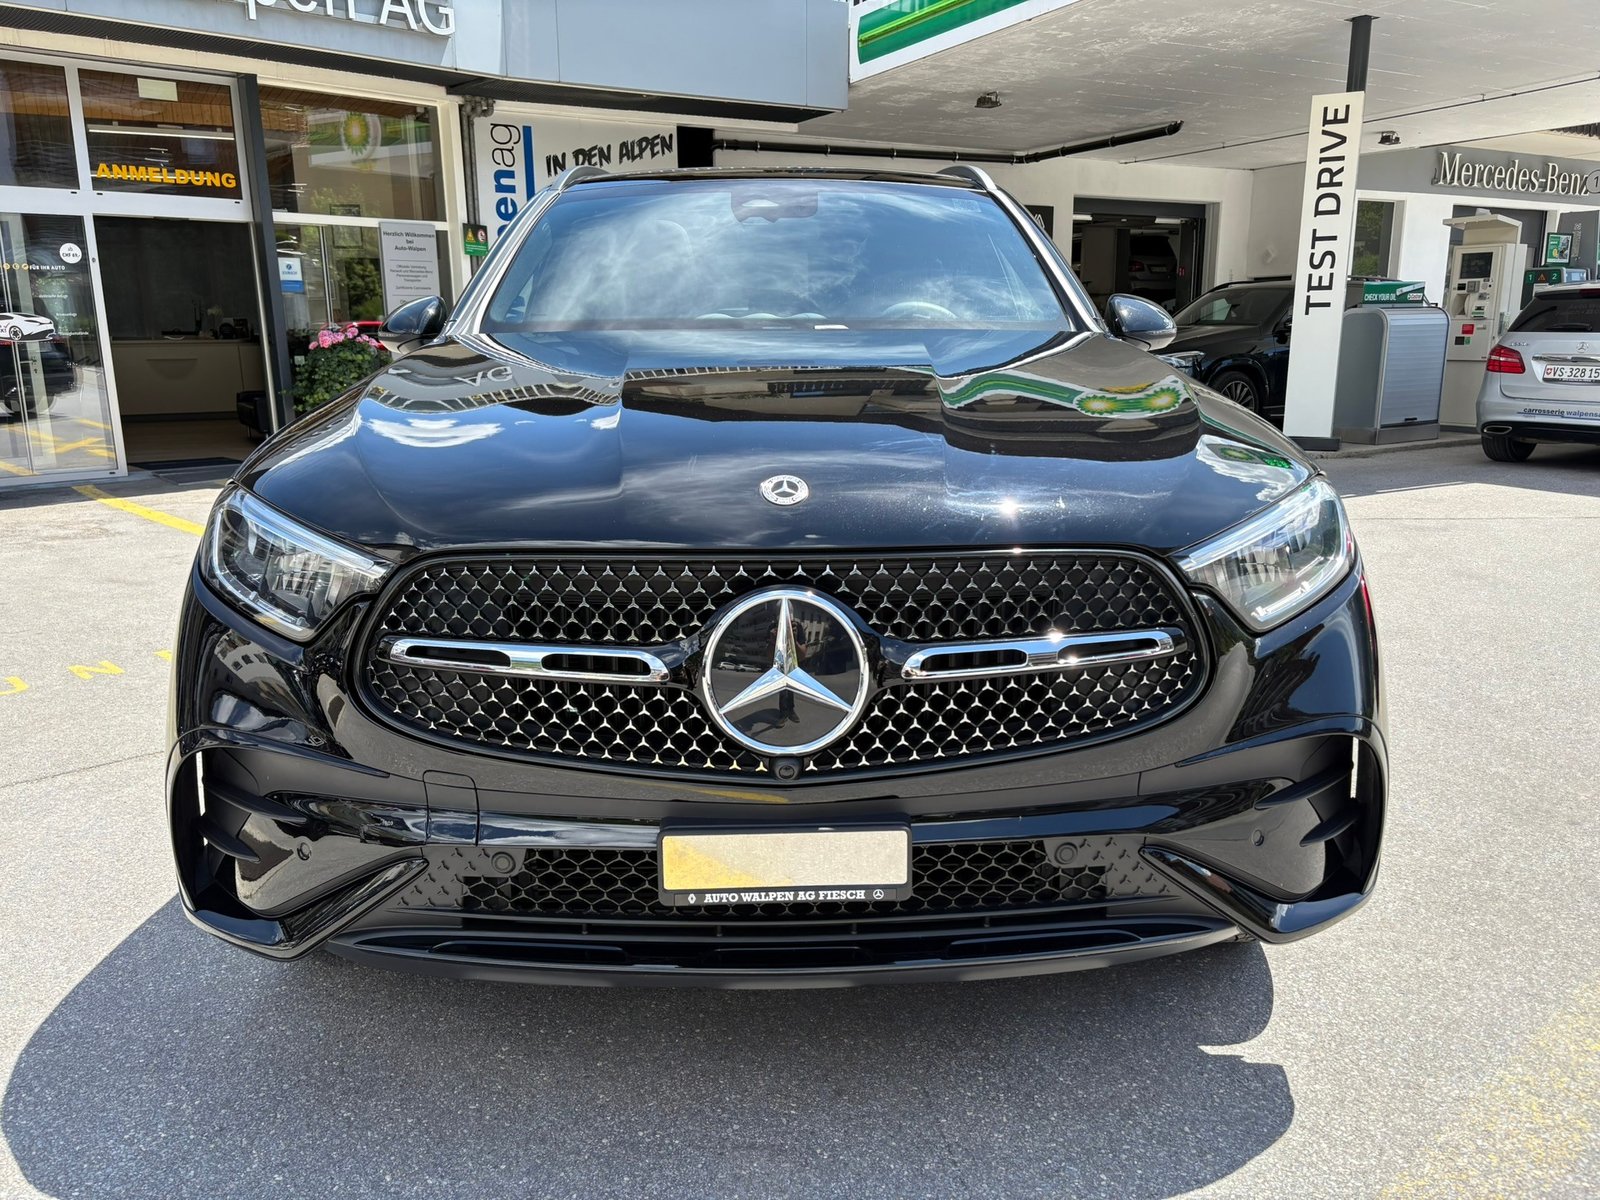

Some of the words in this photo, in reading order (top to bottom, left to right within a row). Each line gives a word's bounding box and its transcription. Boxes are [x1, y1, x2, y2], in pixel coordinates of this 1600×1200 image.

[379, 0, 456, 36] AG
[97, 162, 237, 189] ANMELDUNG
[545, 152, 567, 178] IN
[572, 144, 612, 168] DEN
[618, 133, 674, 165] ALPEN
[1313, 103, 1351, 218] DRIVE
[1438, 151, 1590, 197] Mercedes-Benz
[1304, 228, 1338, 316] TEST
[1523, 408, 1565, 416] carrosserie
[703, 893, 739, 903] AUTO
[740, 891, 795, 902] WALPEN
[796, 891, 816, 901] AG
[818, 889, 866, 900] FIESCH
